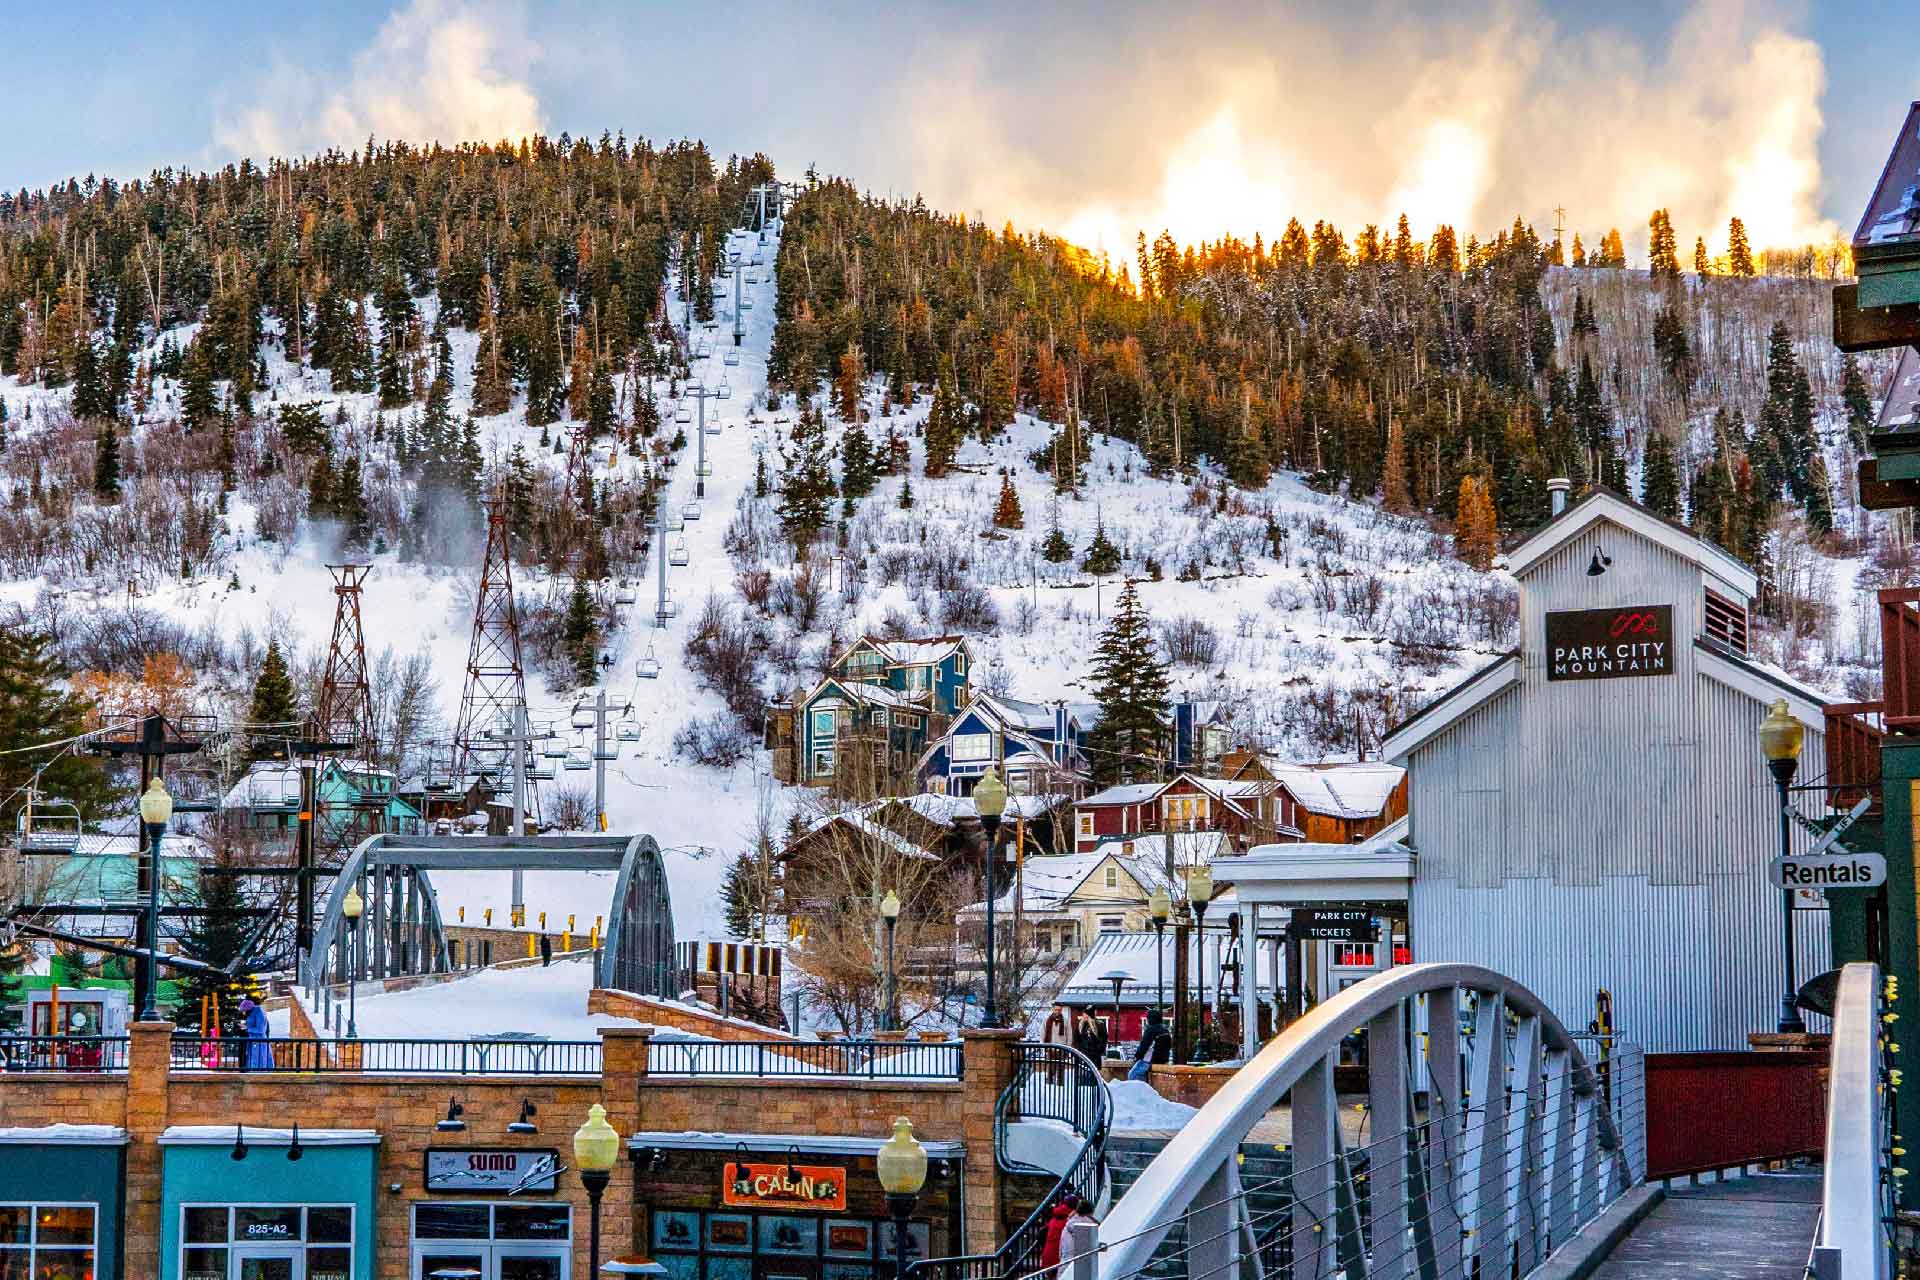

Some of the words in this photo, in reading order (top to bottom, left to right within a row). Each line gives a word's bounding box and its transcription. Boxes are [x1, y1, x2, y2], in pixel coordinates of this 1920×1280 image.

[1555, 645, 1608, 661] PARK
[1616, 641, 1664, 658] CITY
[1554, 657, 1665, 674] MOUNTAIN
[1791, 812, 1821, 838] TOWN
[1834, 813, 1855, 834] LIFT
[1781, 860, 1873, 886] Rentals
[1314, 912, 1341, 920] PARK
[1343, 912, 1367, 920] CITY
[1310, 928, 1352, 937] TICKETS
[467, 1154, 517, 1171] SUMO
[248, 1224, 288, 1234] 825-A2
